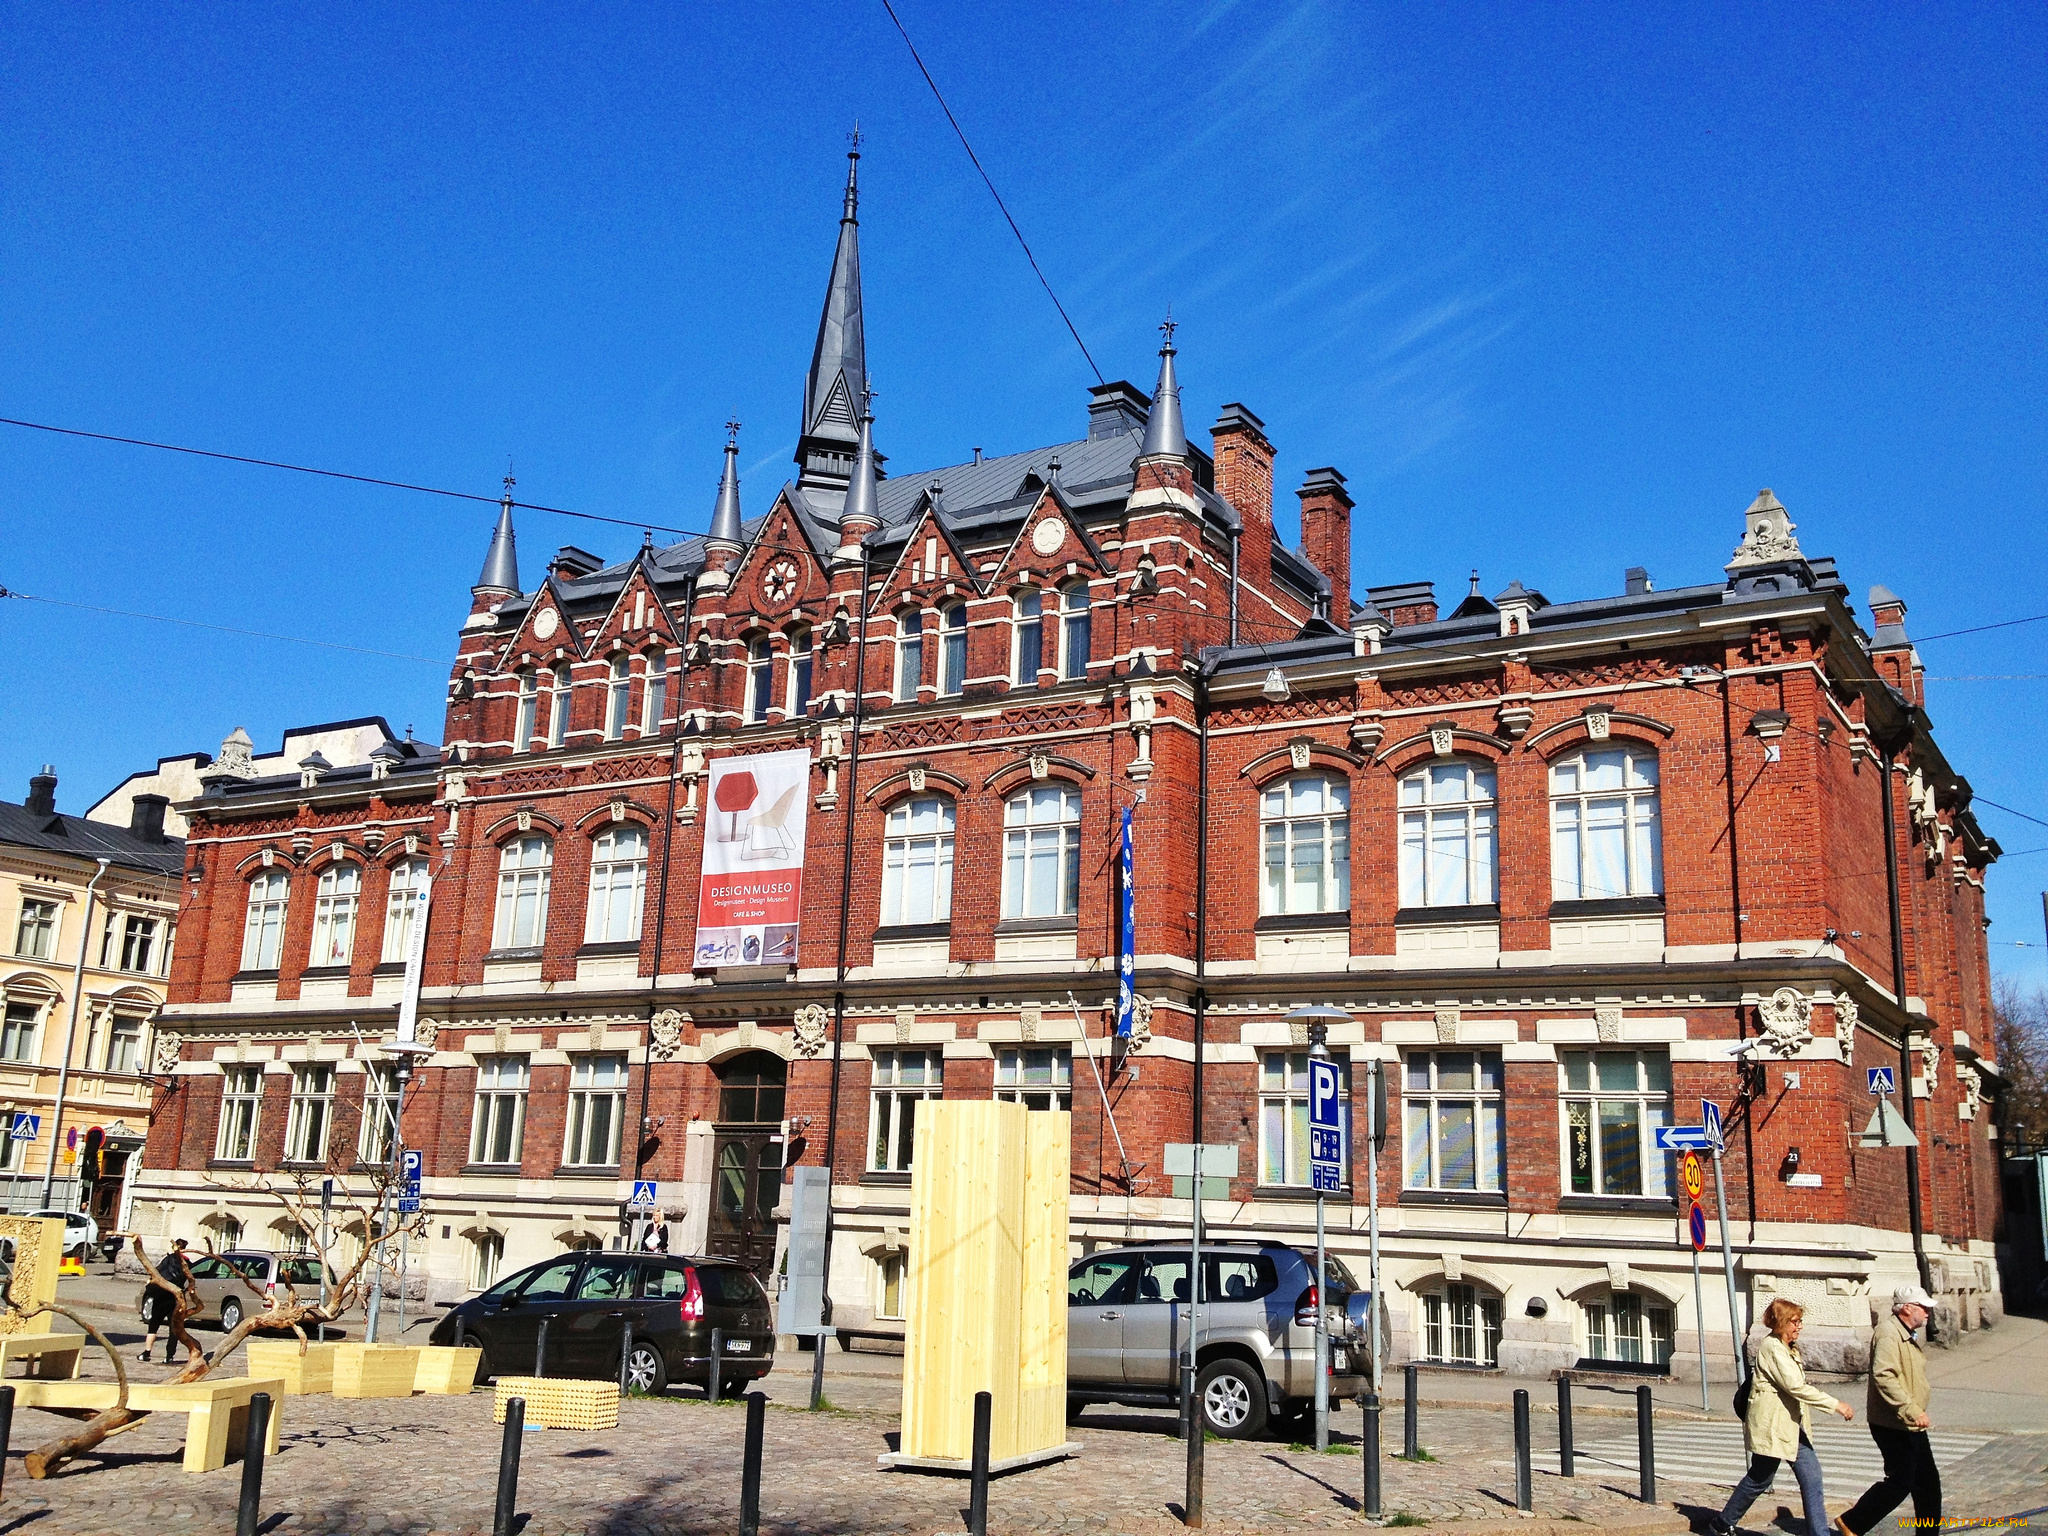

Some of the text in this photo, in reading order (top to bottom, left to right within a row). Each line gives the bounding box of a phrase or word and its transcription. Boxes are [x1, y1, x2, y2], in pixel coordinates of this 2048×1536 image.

[711, 882, 792, 897] DESIGNMUSEO
[713, 899, 746, 907] Designmuseet
[749, 897, 766, 905] Design
[415, 903, 425, 929] WORLD
[411, 931, 422, 957] DESIGN
[1315, 1065, 1335, 1121] P
[404, 1152, 419, 1178] P
[1788, 1152, 1798, 1162] 23
[1686, 1163, 1699, 1188] 30
